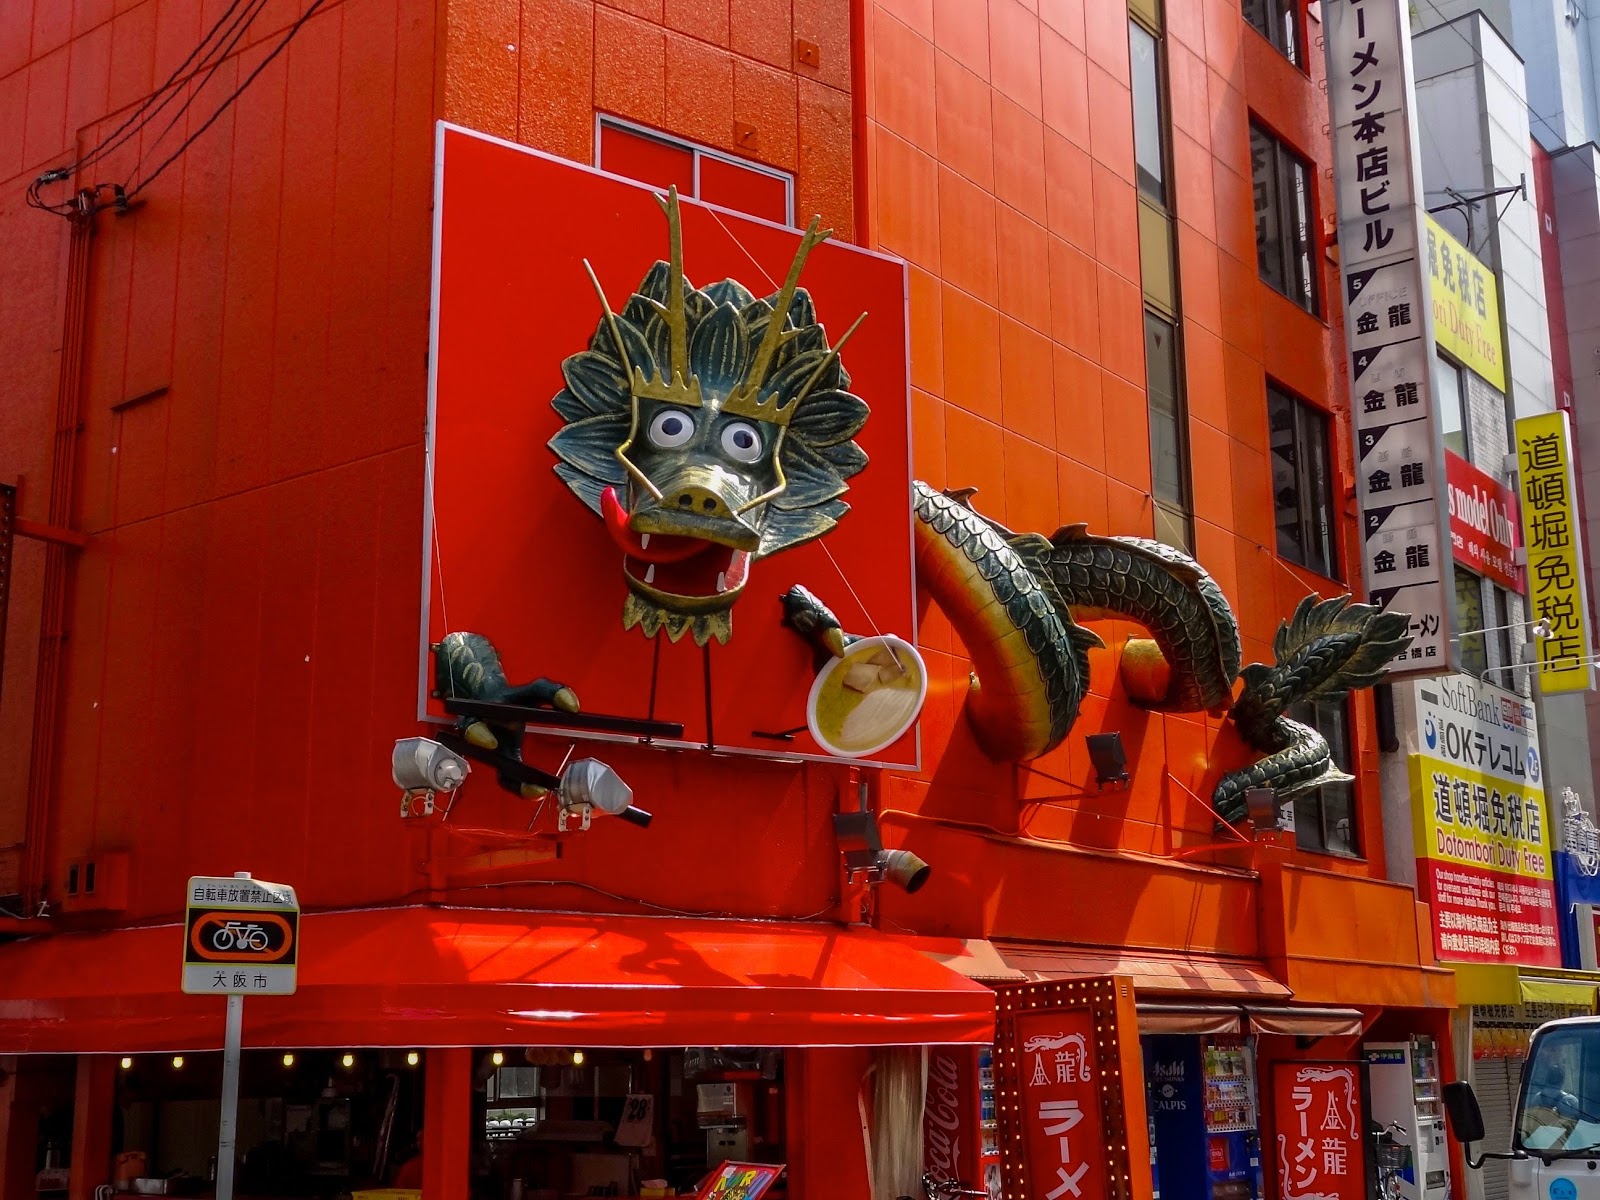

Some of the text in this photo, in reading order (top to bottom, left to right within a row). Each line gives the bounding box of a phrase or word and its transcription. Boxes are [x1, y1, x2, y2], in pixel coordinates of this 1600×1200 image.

[1350, 0, 1394, 252] ーメン本店ビル
[1353, 278, 1362, 290] 5
[1358, 355, 1368, 367] 4
[1365, 434, 1374, 446] 3
[1370, 515, 1379, 527] 2
[1455, 484, 1491, 537] model
[1489, 498, 1514, 562] Only
[1522, 432, 1581, 674] 道頓堀免税店
[1402, 613, 1439, 638] ーメン
[1441, 675, 1501, 727] SoftBank
[1446, 722, 1527, 780] OKテレコム
[1433, 773, 1542, 844] 道頓堀免税店
[1436, 827, 1545, 874] Dotombori Duty Free
[213, 974, 267, 988] 大阪市
[1029, 1050, 1077, 1087] 金龍
[627, 1098, 648, 1121] 28
[925, 1054, 960, 1200] oca-Cola
[1320, 1090, 1348, 1175] 金龍
[1038, 1099, 1090, 1200] ラーメ
[1291, 1086, 1318, 1189] ラーメン
